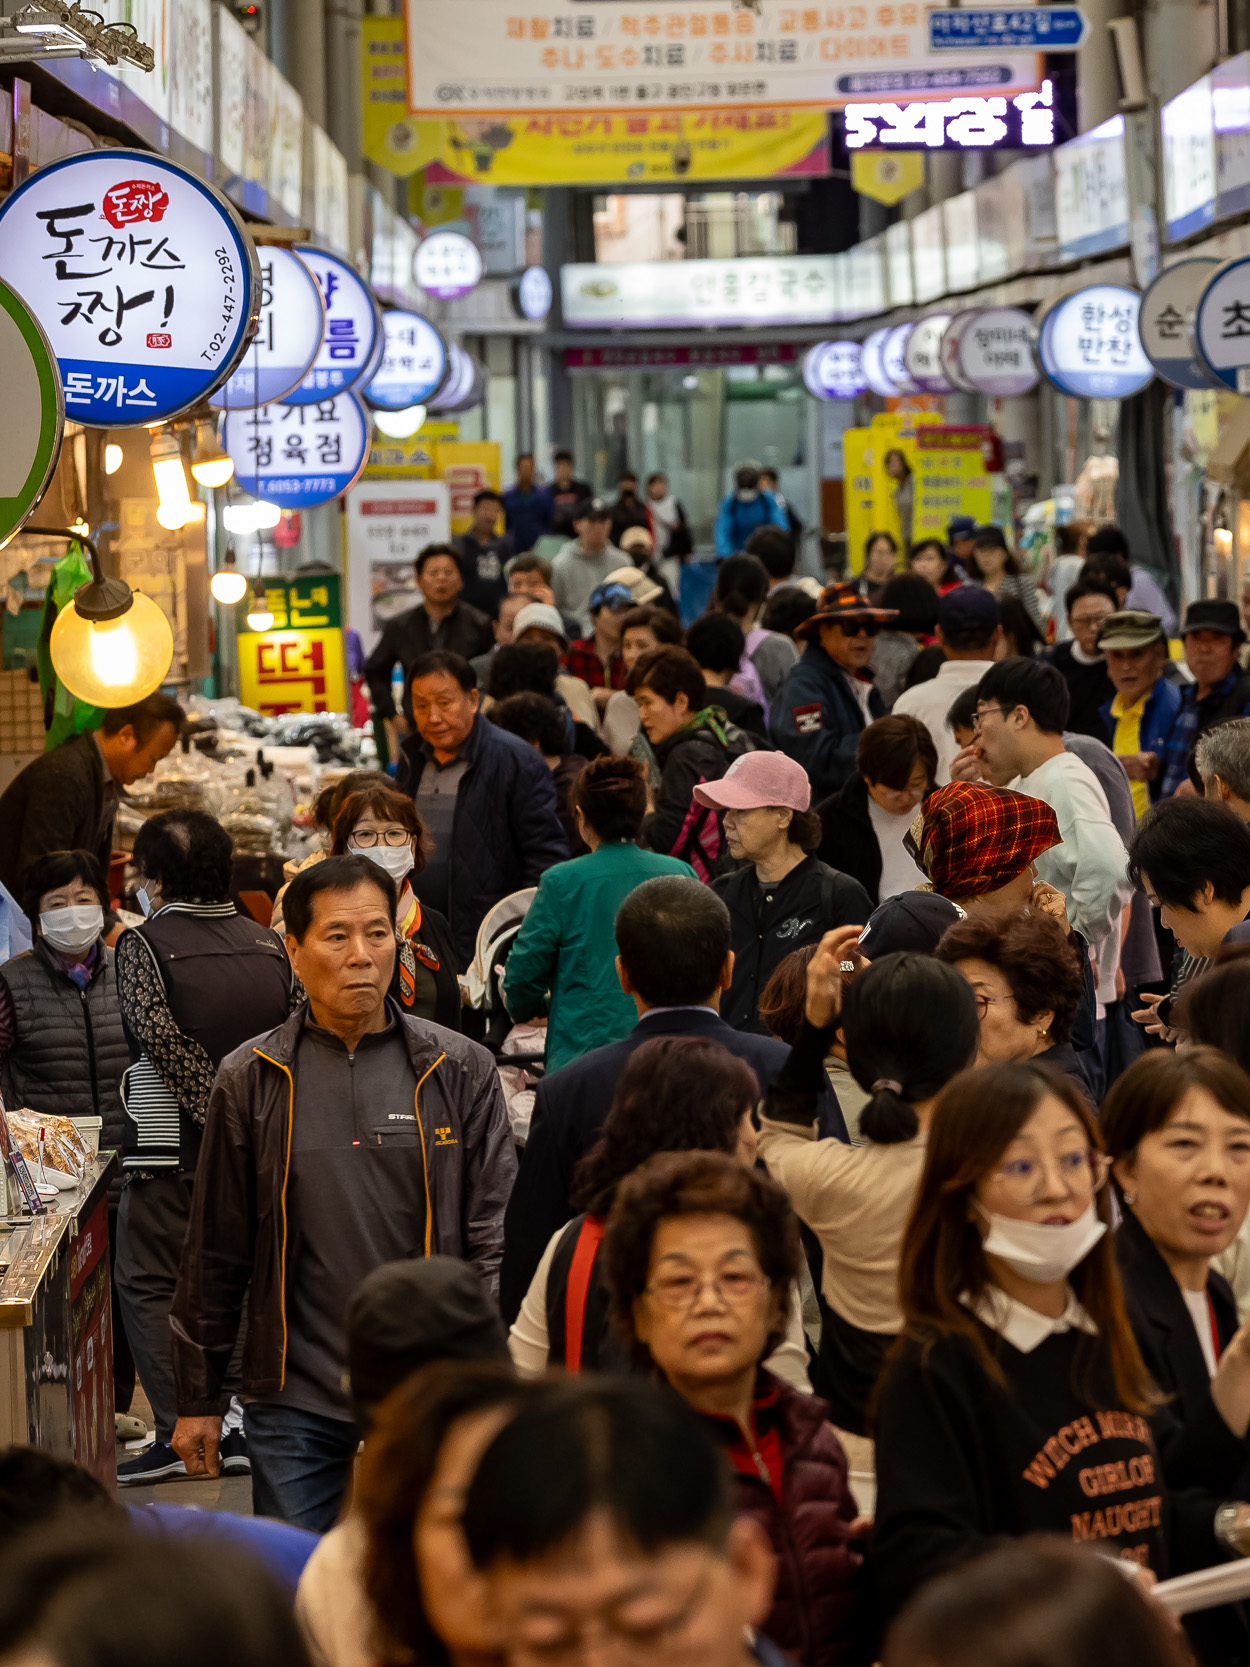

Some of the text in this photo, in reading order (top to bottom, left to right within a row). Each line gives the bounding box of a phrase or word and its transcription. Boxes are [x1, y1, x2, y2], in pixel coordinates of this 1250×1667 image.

[107, 186, 163, 222] 돈짱
[36, 203, 187, 281] 돈까스
[57, 285, 175, 346] 짱!
[201, 246, 236, 362] T.02-447-2292
[63, 372, 157, 407] 돈까스
[248, 433, 343, 467] 정육점
[257, 641, 326, 696] 떡
